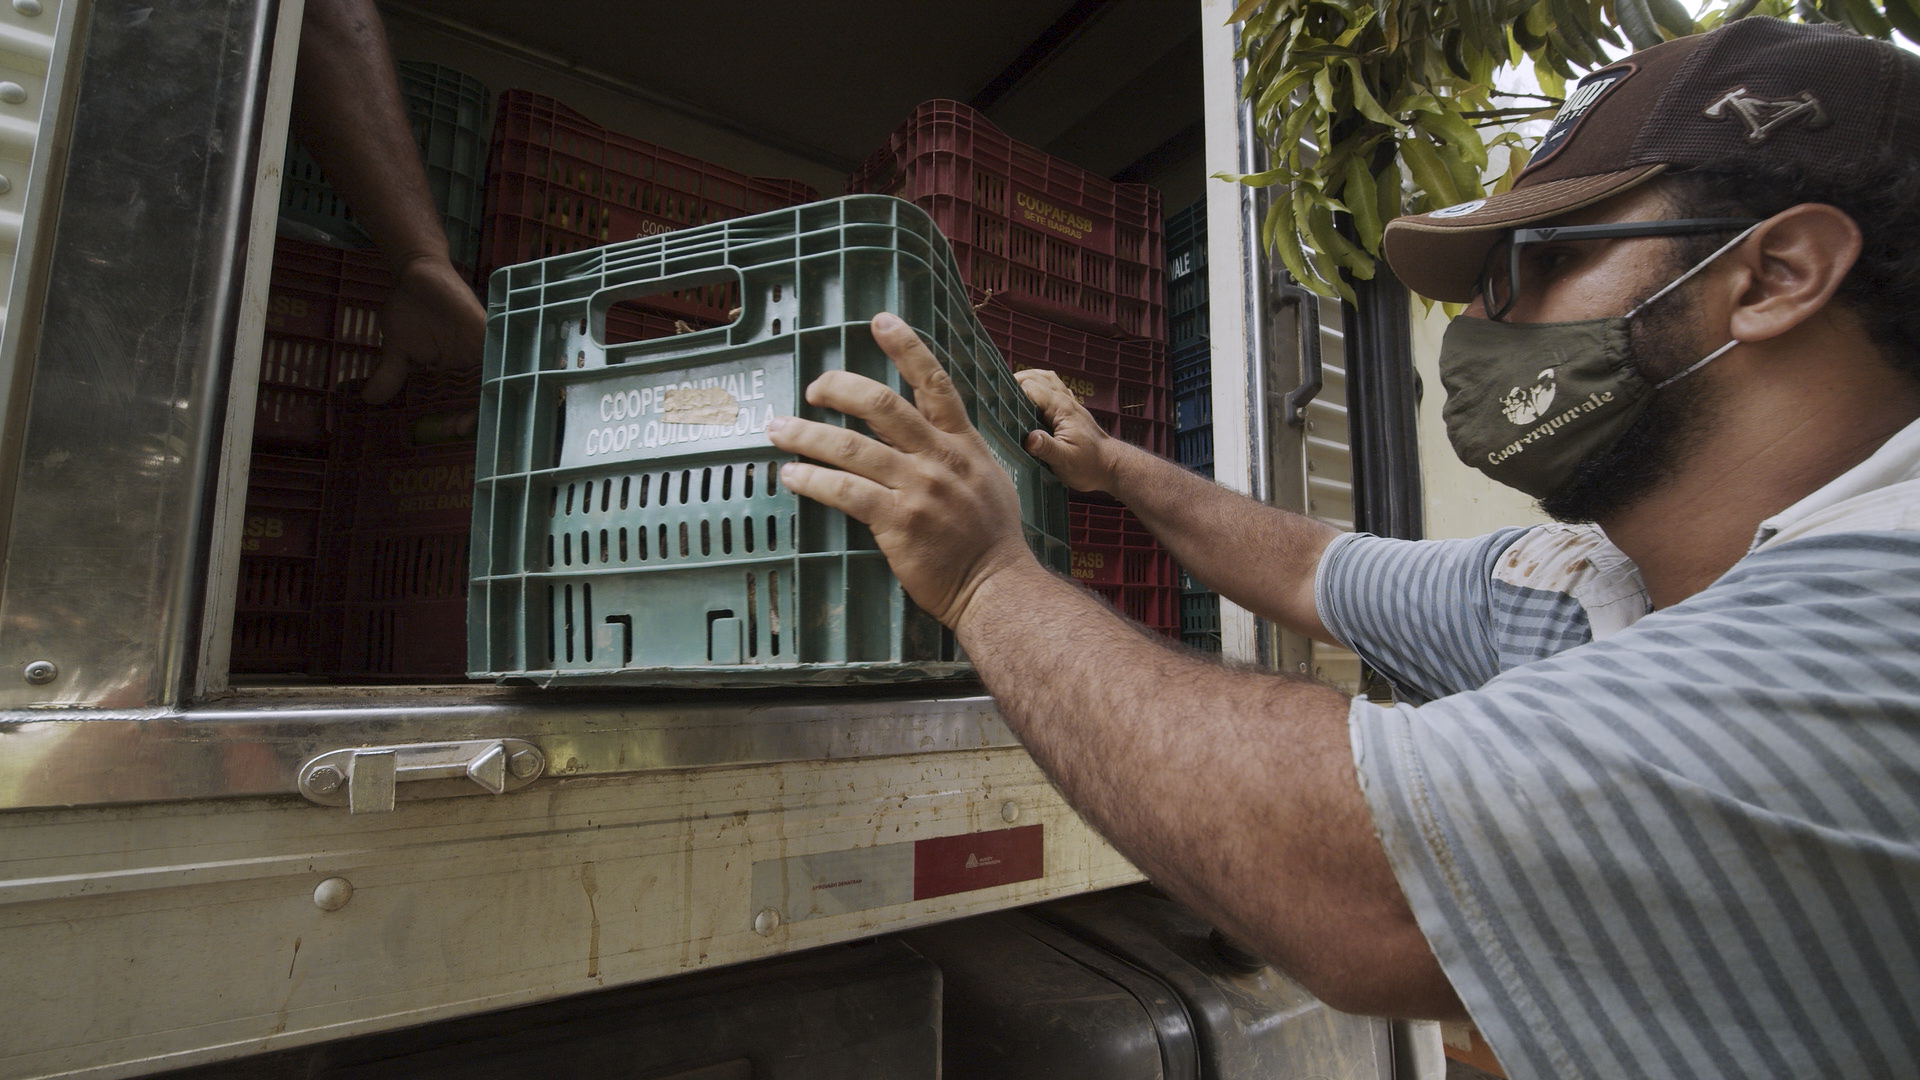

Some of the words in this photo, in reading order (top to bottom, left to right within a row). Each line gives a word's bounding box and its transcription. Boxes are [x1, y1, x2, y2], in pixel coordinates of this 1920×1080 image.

[1016, 191, 1093, 233] COOPAFASB
[642, 220, 678, 235] COOP
[1023, 209, 1047, 226] SETE
[1047, 219, 1083, 240] BARRAS
[1070, 551, 1104, 569] FASB
